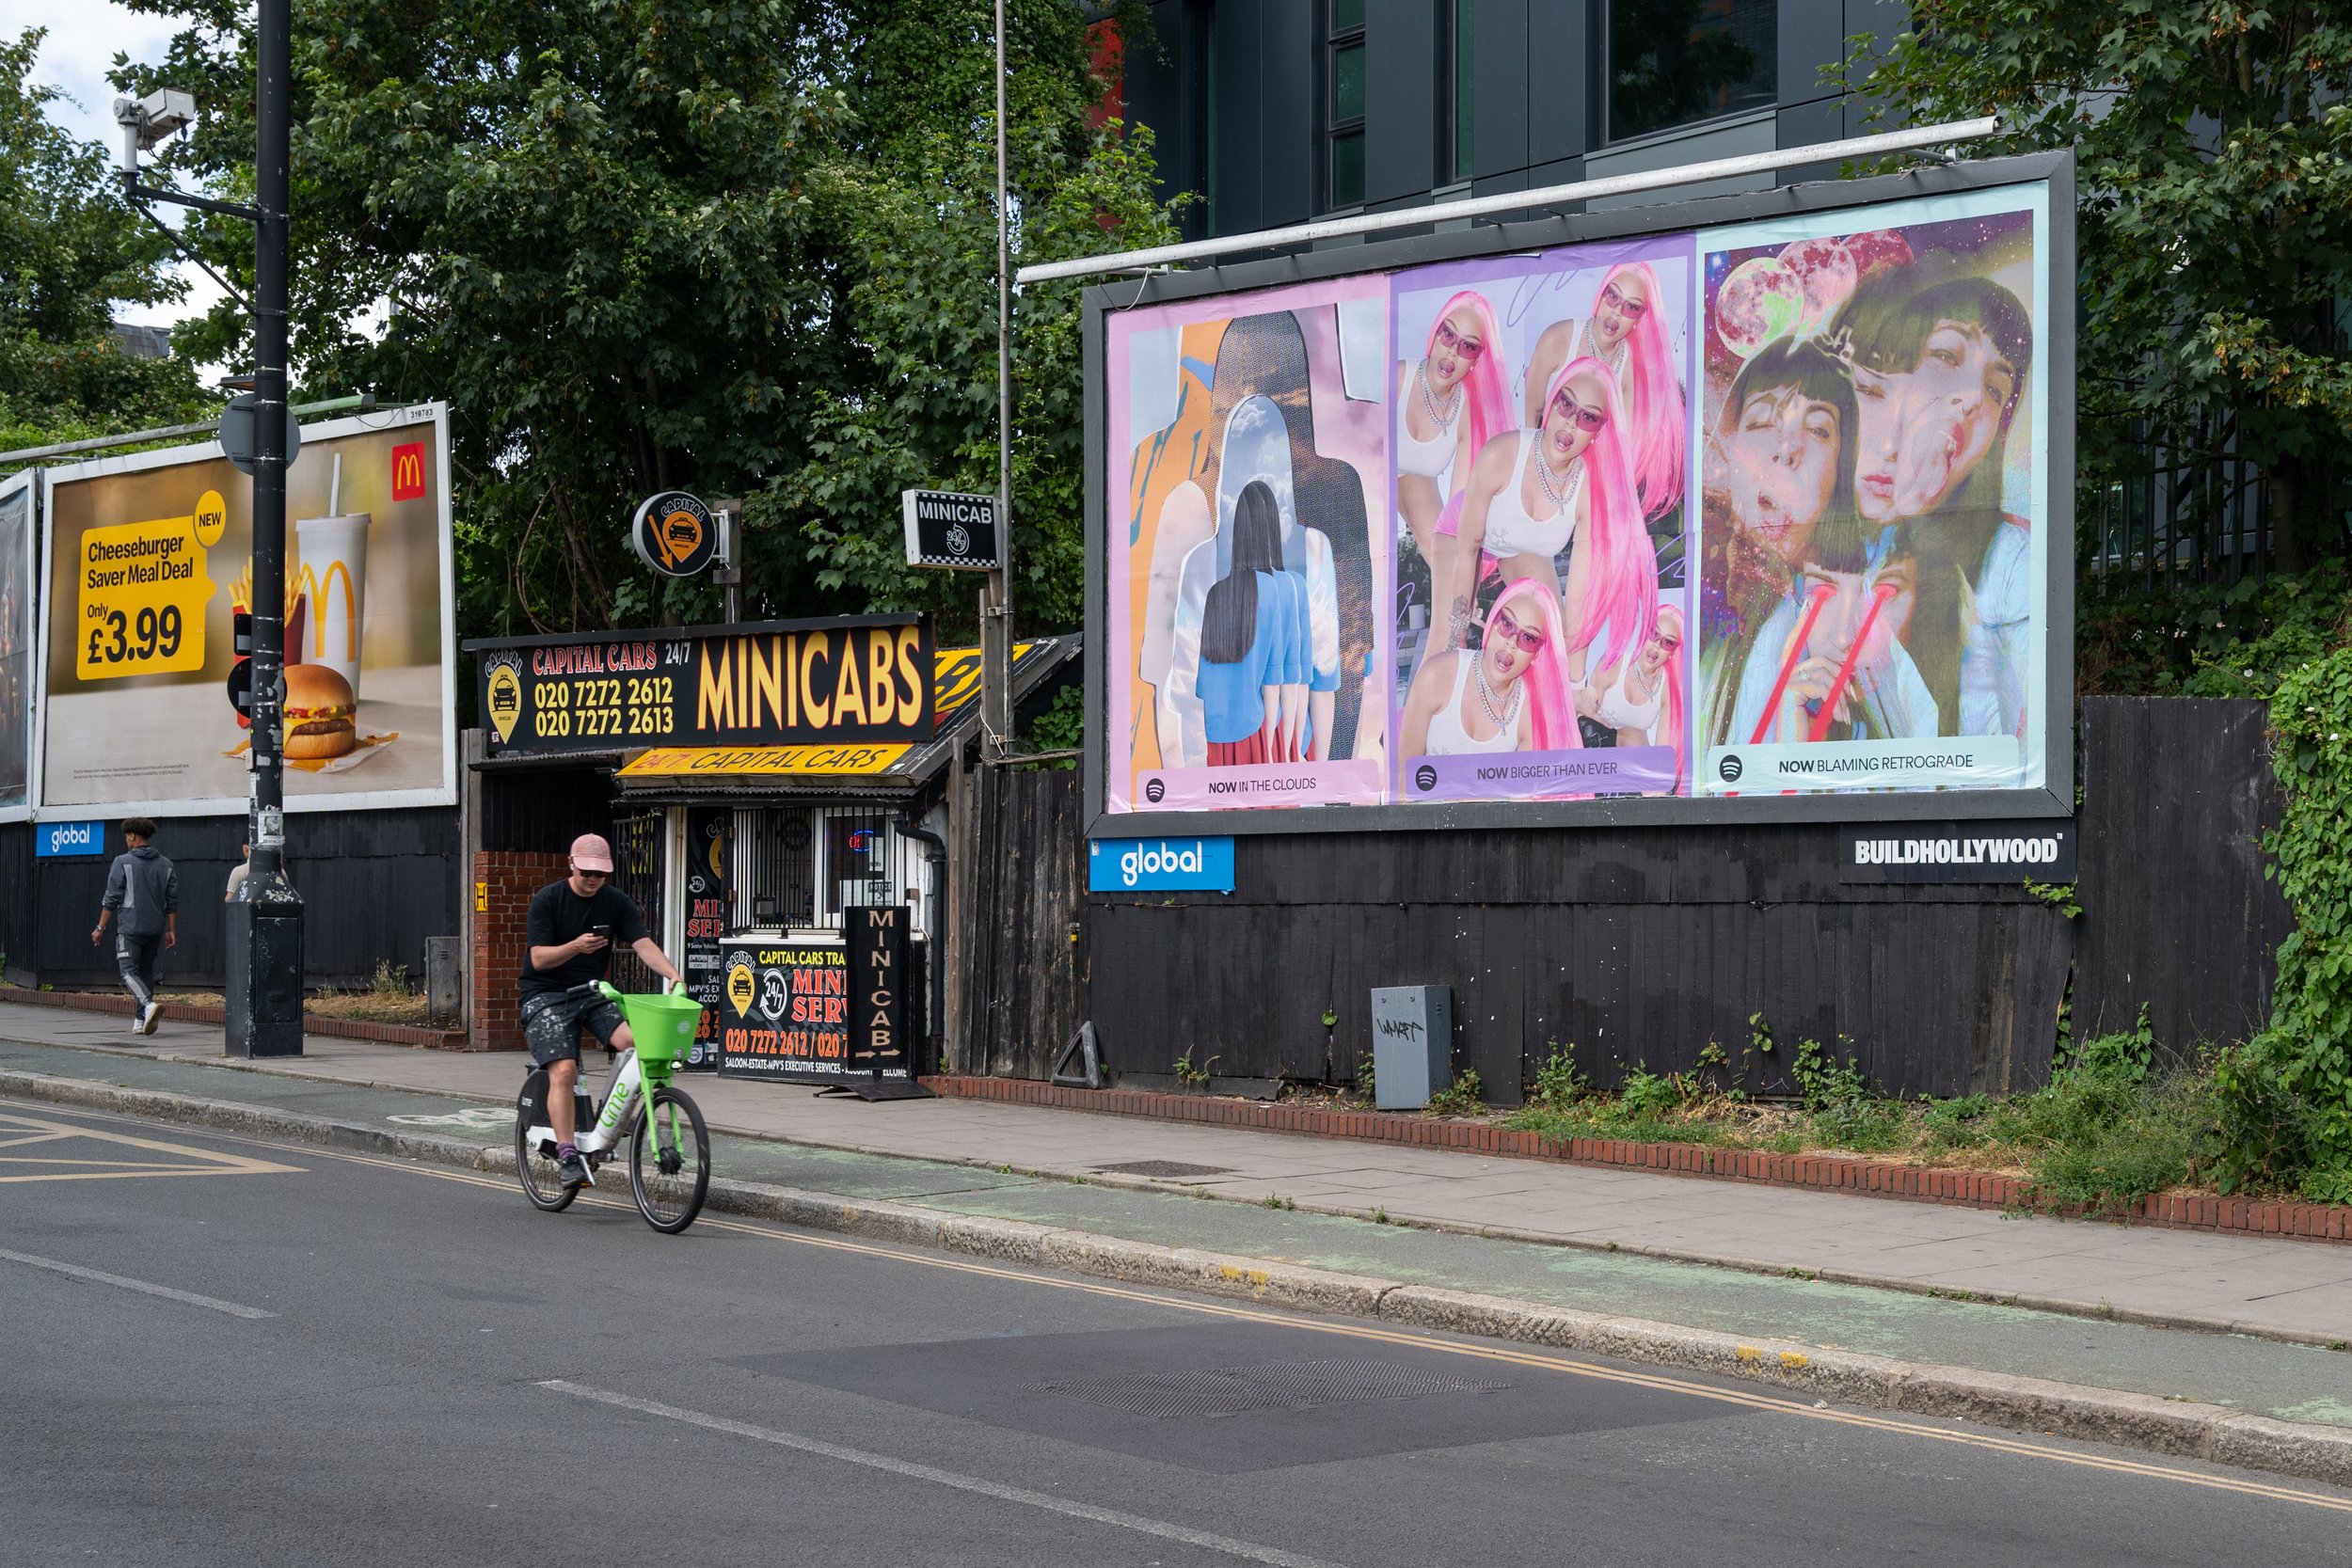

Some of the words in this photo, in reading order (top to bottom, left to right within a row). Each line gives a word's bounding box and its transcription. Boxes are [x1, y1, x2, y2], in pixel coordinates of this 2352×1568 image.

[199, 512, 222, 528] NEW
[660, 499, 706, 522] CAPITAL
[918, 501, 993, 524] MINICAB
[88, 536, 184, 562] Cheeseburger
[946, 530, 966, 550] 24/7
[87, 569, 126, 590] Saver
[127, 561, 159, 585] Meal
[162, 557, 194, 580] Deal
[87, 604, 108, 621] Only
[87, 605, 183, 664] £3.99
[485, 647, 523, 678] CAPITAL
[532, 644, 604, 676] CAPITAL
[607, 641, 658, 672] CARS
[665, 642, 691, 666] 24/7
[696, 626, 922, 733] MINICABS
[534, 682, 569, 709] 020
[574, 679, 622, 706] 7272
[628, 676, 674, 705] 2612
[535, 710, 570, 737] 020
[576, 708, 623, 736] 7272
[628, 706, 674, 734] 2613
[633, 753, 691, 769] 24/7
[691, 751, 802, 769] CAPITAL
[804, 749, 889, 768] CARS
[1477, 767, 1508, 780] NOW
[1510, 766, 1550, 778] BIGGER
[1552, 763, 1585, 776] THAN
[1588, 762, 1618, 775] EVER
[1779, 760, 1815, 773] NOW
[1817, 757, 1879, 772] BLAMING
[1882, 754, 1974, 769] RETROGRADE
[1209, 782, 1237, 794] NOW
[1239, 782, 1248, 793] IN
[1250, 780, 1271, 792] THE
[1272, 777, 1316, 791] CLOUDS
[52, 823, 90, 853] global
[1120, 841, 1202, 886] global
[1855, 838, 2058, 864] BUILDHOLLYWOOD
[692, 898, 721, 918] MI
[725, 950, 755, 974] CAPITAL
[759, 950, 797, 965] CAPITAL
[799, 952, 824, 965] CARS
[688, 984, 710, 993] MPV'S
[869, 910, 894, 1047] MINICAB
[698, 994, 720, 1003] ACCO
[765, 981, 784, 1009] 24/7
[725, 1028, 748, 1053] 020
[750, 1029, 778, 1054] 7272
[779, 1031, 808, 1056] 2612
[809, 1032, 815, 1058] /
[818, 1033, 840, 1058] 020
[785, 1061, 815, 1072] EXECUTIVE
[815, 1062, 841, 1074] SERVICES
[599, 1082, 630, 1129] Lime
